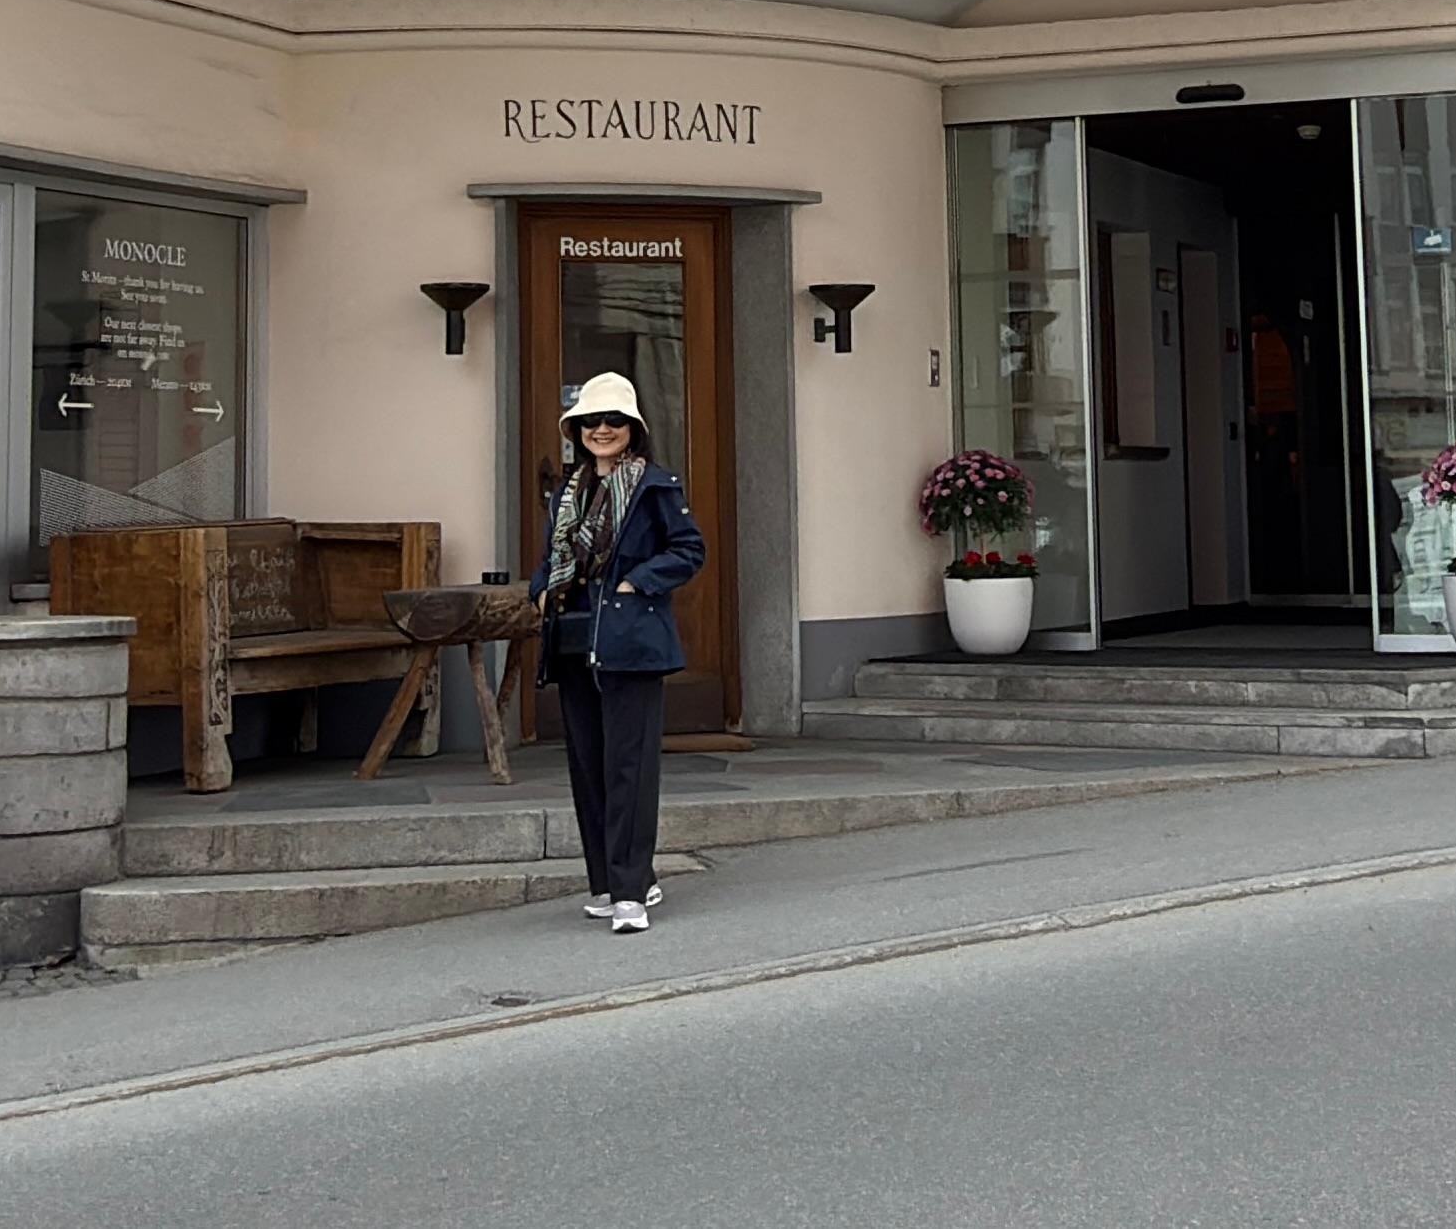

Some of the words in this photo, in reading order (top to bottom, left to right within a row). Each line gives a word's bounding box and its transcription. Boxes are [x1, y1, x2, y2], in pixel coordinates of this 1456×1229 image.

[503, 98, 762, 145] RESTAURANT
[103, 237, 187, 267] MONOCLE
[559, 236, 684, 258] Restaurant
